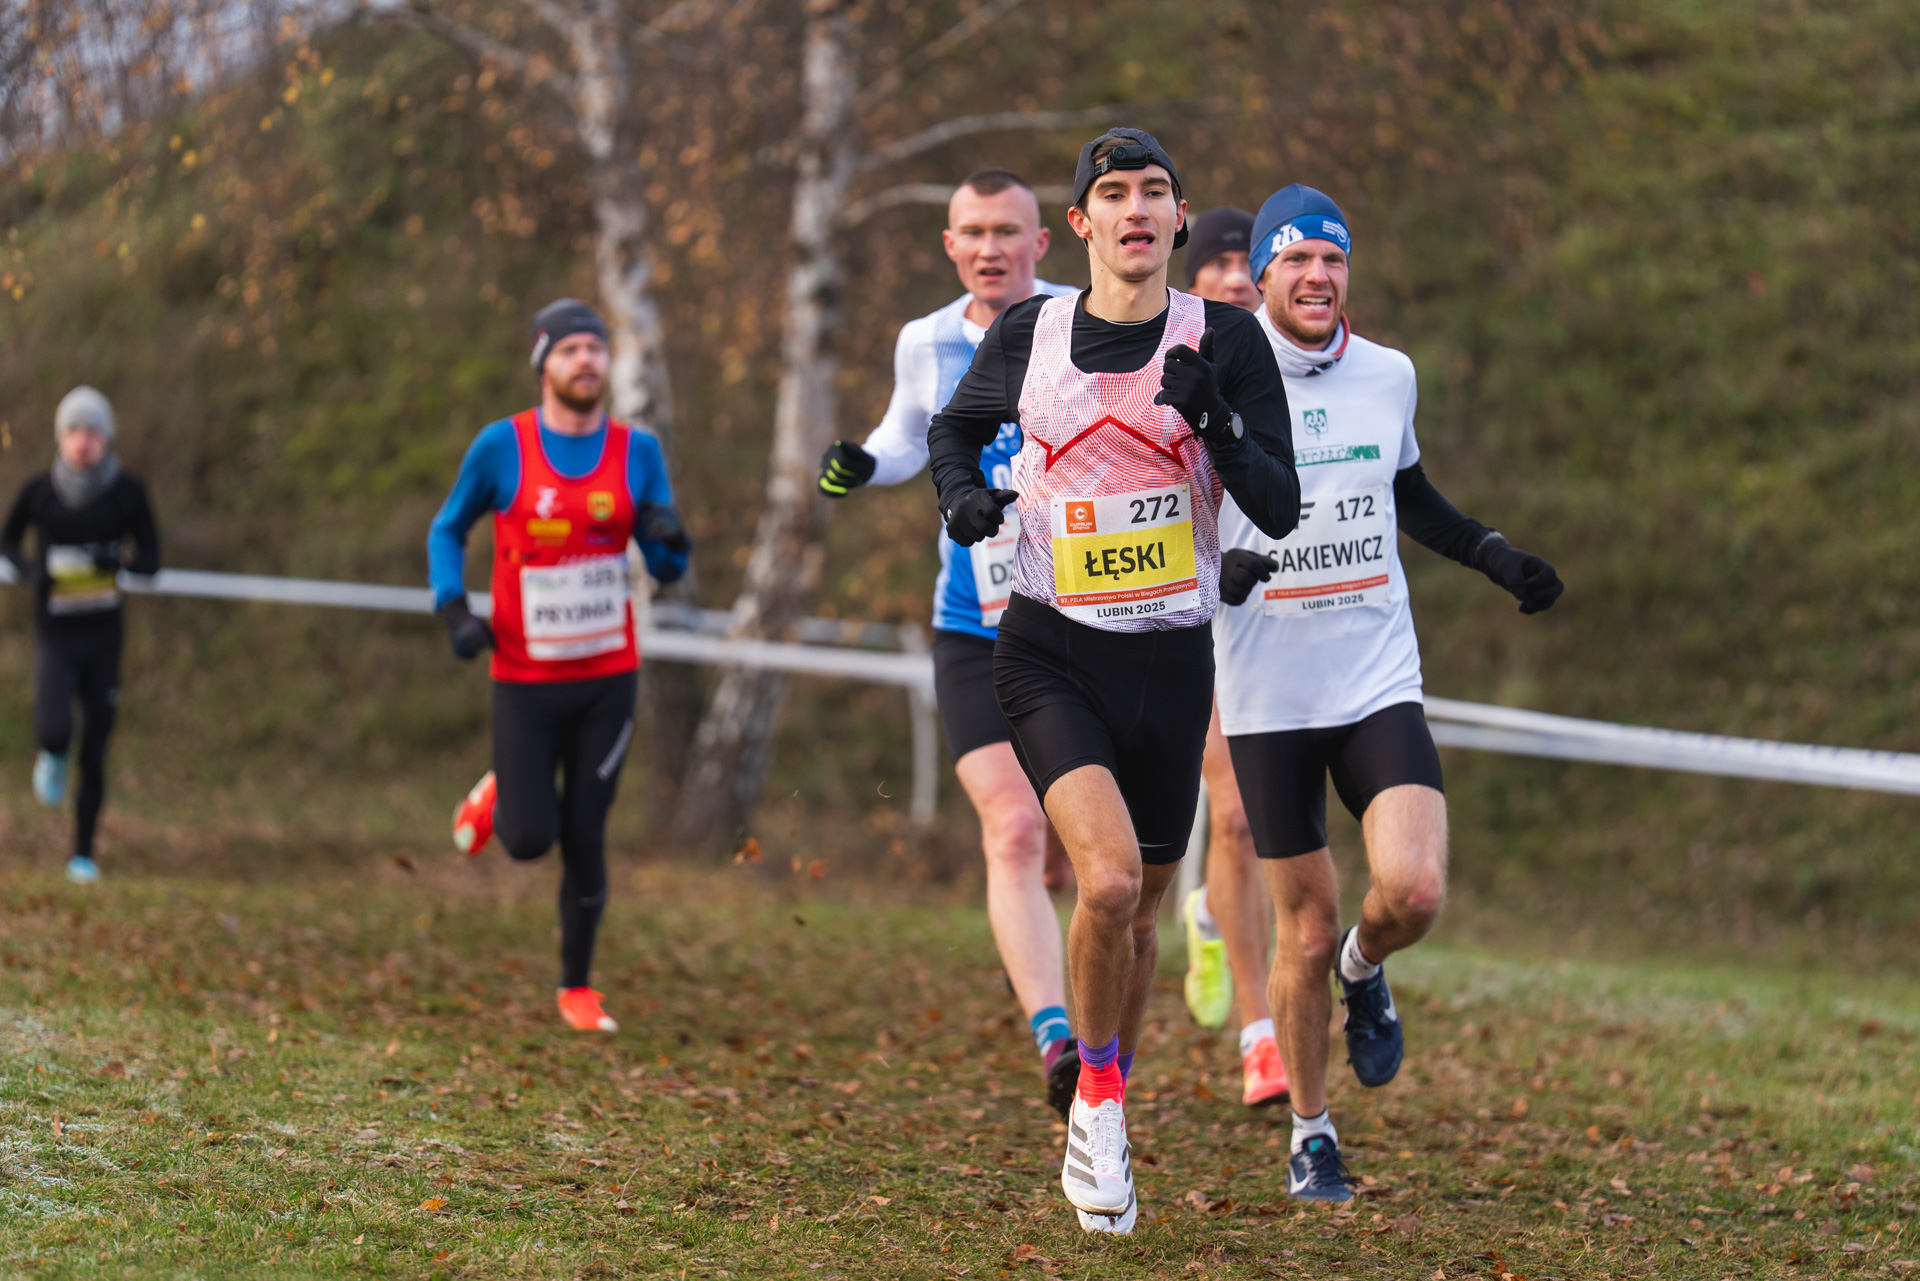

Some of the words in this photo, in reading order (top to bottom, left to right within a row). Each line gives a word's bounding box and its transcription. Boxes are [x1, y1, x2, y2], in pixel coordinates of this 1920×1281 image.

[1129, 493, 1180, 524] 272
[1335, 495, 1375, 522] 172
[1084, 542, 1166, 581] ŁĘSKI
[1140, 588, 1163, 597] Biegach
[1302, 598, 1335, 610] LUBIN
[1337, 594, 1365, 605] 2025
[1097, 605, 1133, 618] LUBIN
[1136, 600, 1166, 615] 2025
